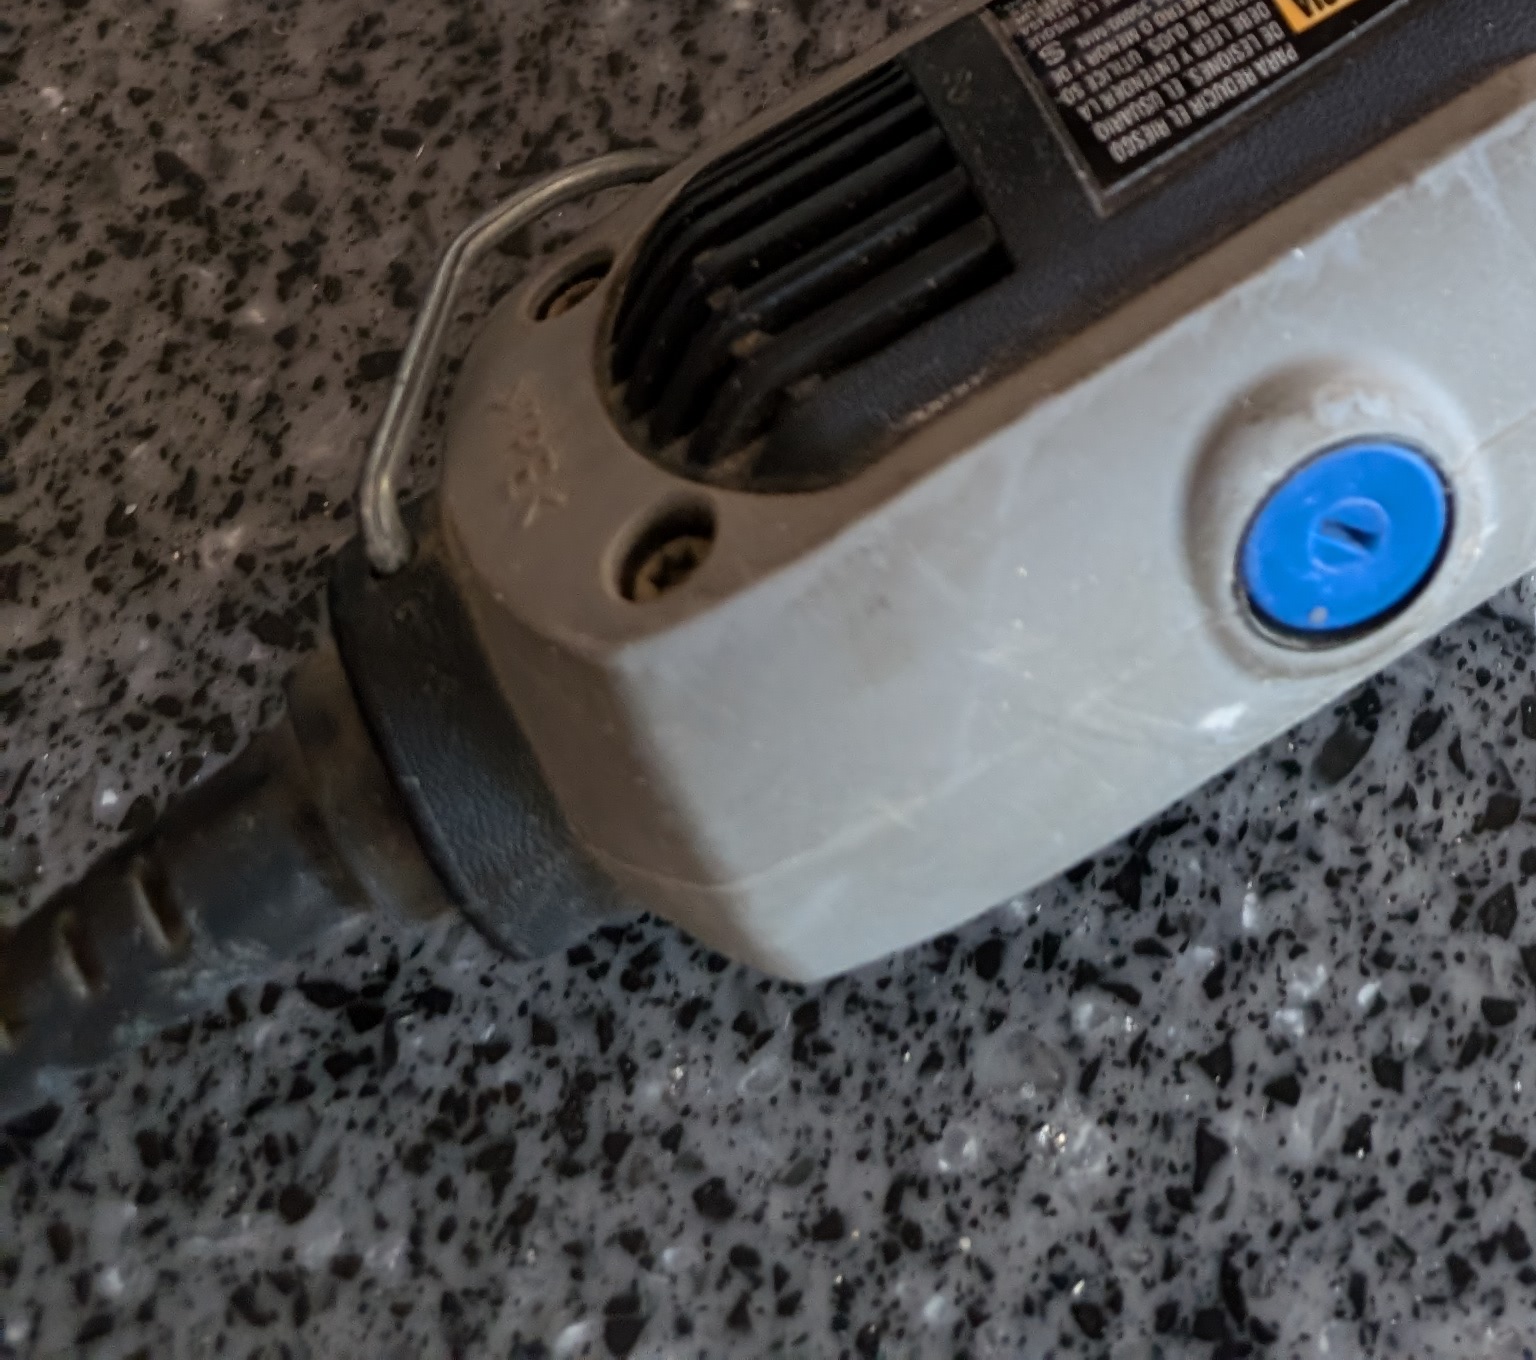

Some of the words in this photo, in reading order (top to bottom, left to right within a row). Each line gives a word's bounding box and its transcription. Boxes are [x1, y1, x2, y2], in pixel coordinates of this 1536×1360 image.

[1132, 14, 1154, 35] O
[1181, 8, 1211, 32] DE
[1229, 1, 1271, 33] DEBE
[1084, 24, 1140, 66] MENOR
[1190, 23, 1231, 56] LEER
[1258, 20, 1284, 45] DE
[1071, 58, 1086, 73] Y
[1084, 44, 1142, 91] UTILICE
[1179, 46, 1193, 64] Y
[1252, 43, 1298, 77] PARA
[1049, 64, 1073, 86] DE
[1099, 53, 1179, 109] ENTENDER
[1160, 77, 1186, 100] EL
[1187, 67, 1257, 116] REDUCIR
[1076, 97, 1102, 121] LA
[1092, 90, 1163, 140] USUARIO
[1165, 103, 1191, 127] EL
[1109, 119, 1170, 162] RIESGO
